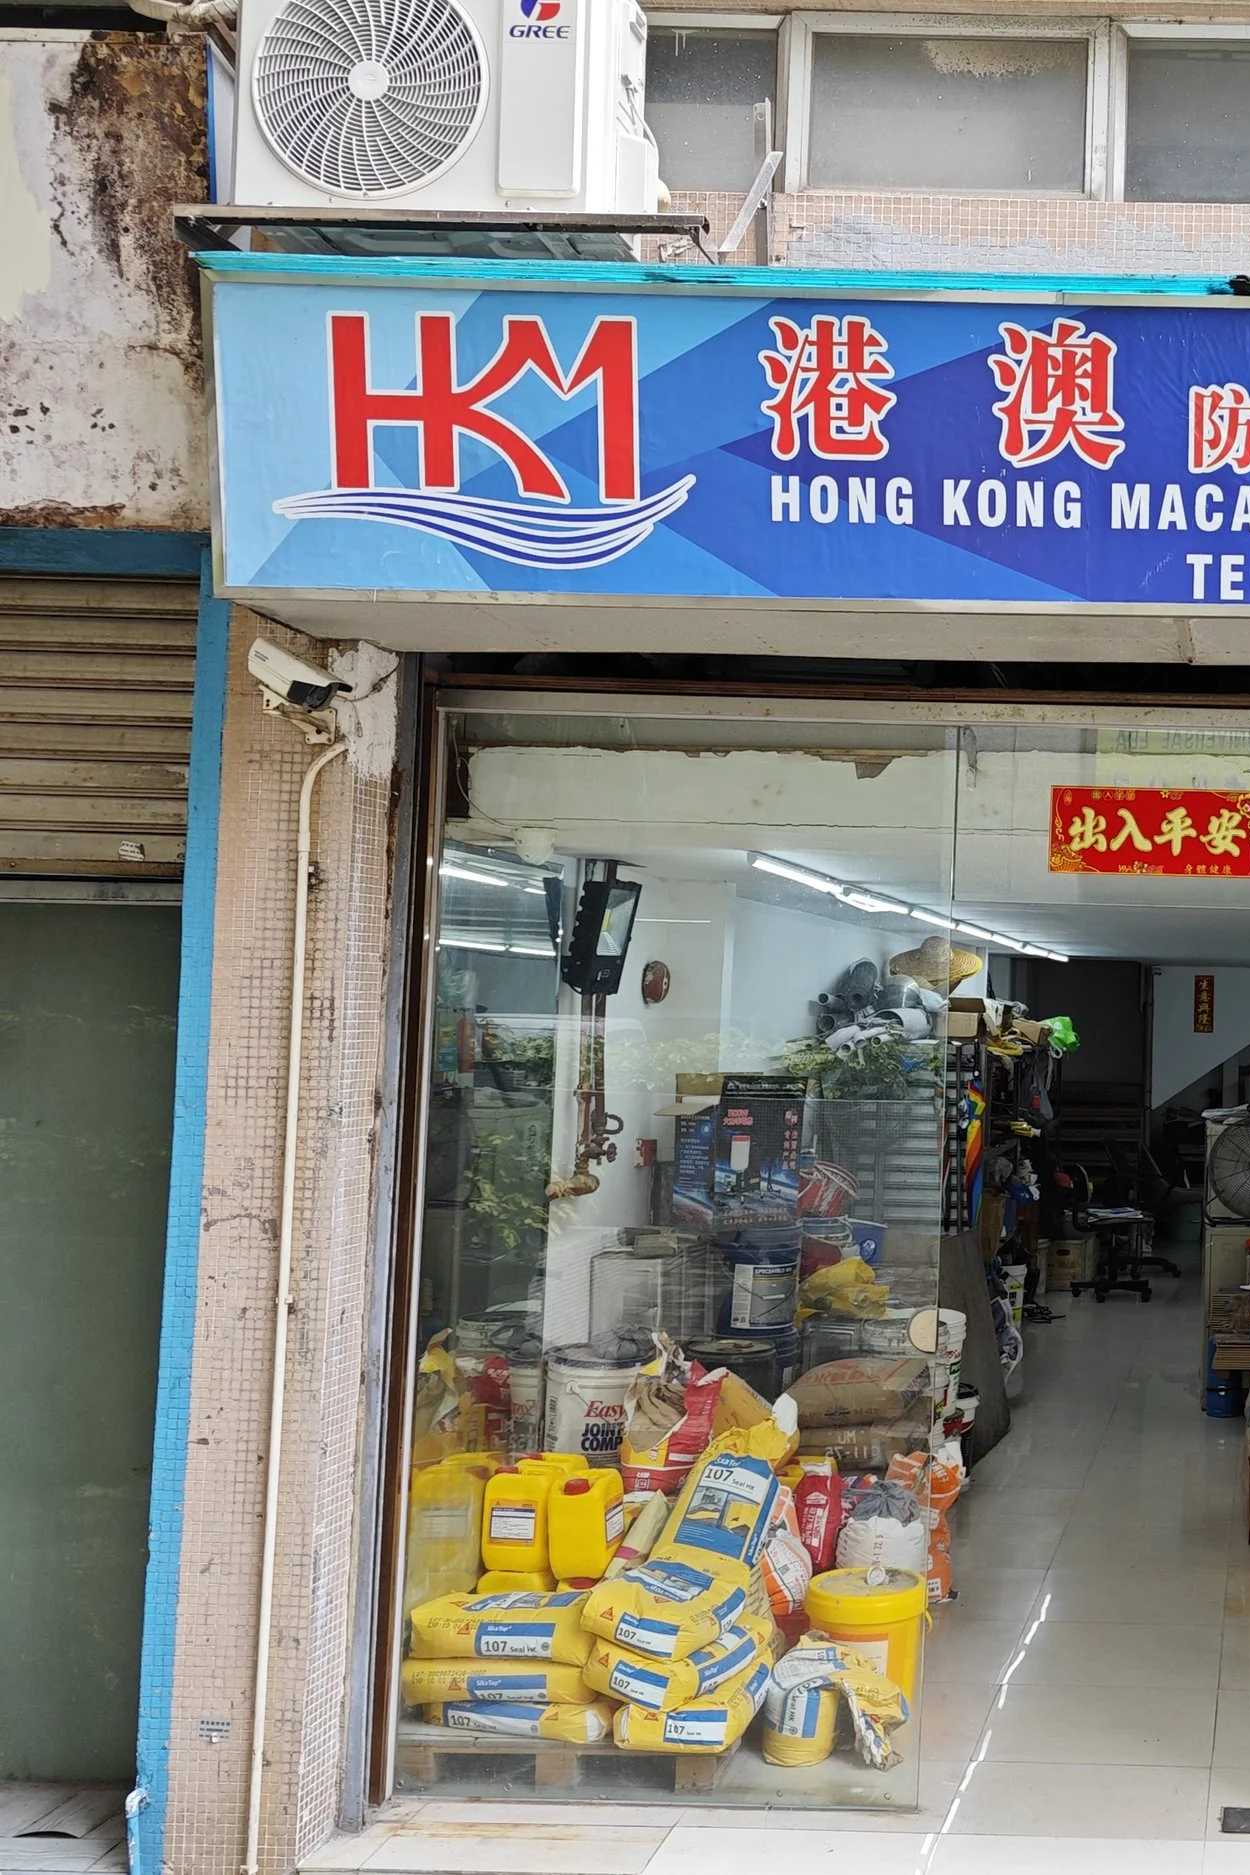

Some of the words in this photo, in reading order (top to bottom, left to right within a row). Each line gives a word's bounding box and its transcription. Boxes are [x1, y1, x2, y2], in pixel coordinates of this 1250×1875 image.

[509, 24, 571, 39] GREE
[328, 312, 638, 503] HKM
[770, 476, 914, 525] HONG
[943, 479, 1083, 529] KONG
[1068, 805, 1248, 857] 出入平安
[1184, 863, 1233, 876] 身體健康
[584, 1400, 625, 1422] Easy
[582, 1423, 623, 1437] JOINT
[704, 1468, 733, 1482] 107
[617, 1627, 637, 1640] 107
[484, 1641, 507, 1653] 107
[613, 1676, 631, 1690] 107
[451, 1715, 471, 1727] 107
[667, 1723, 685, 1735] 107
